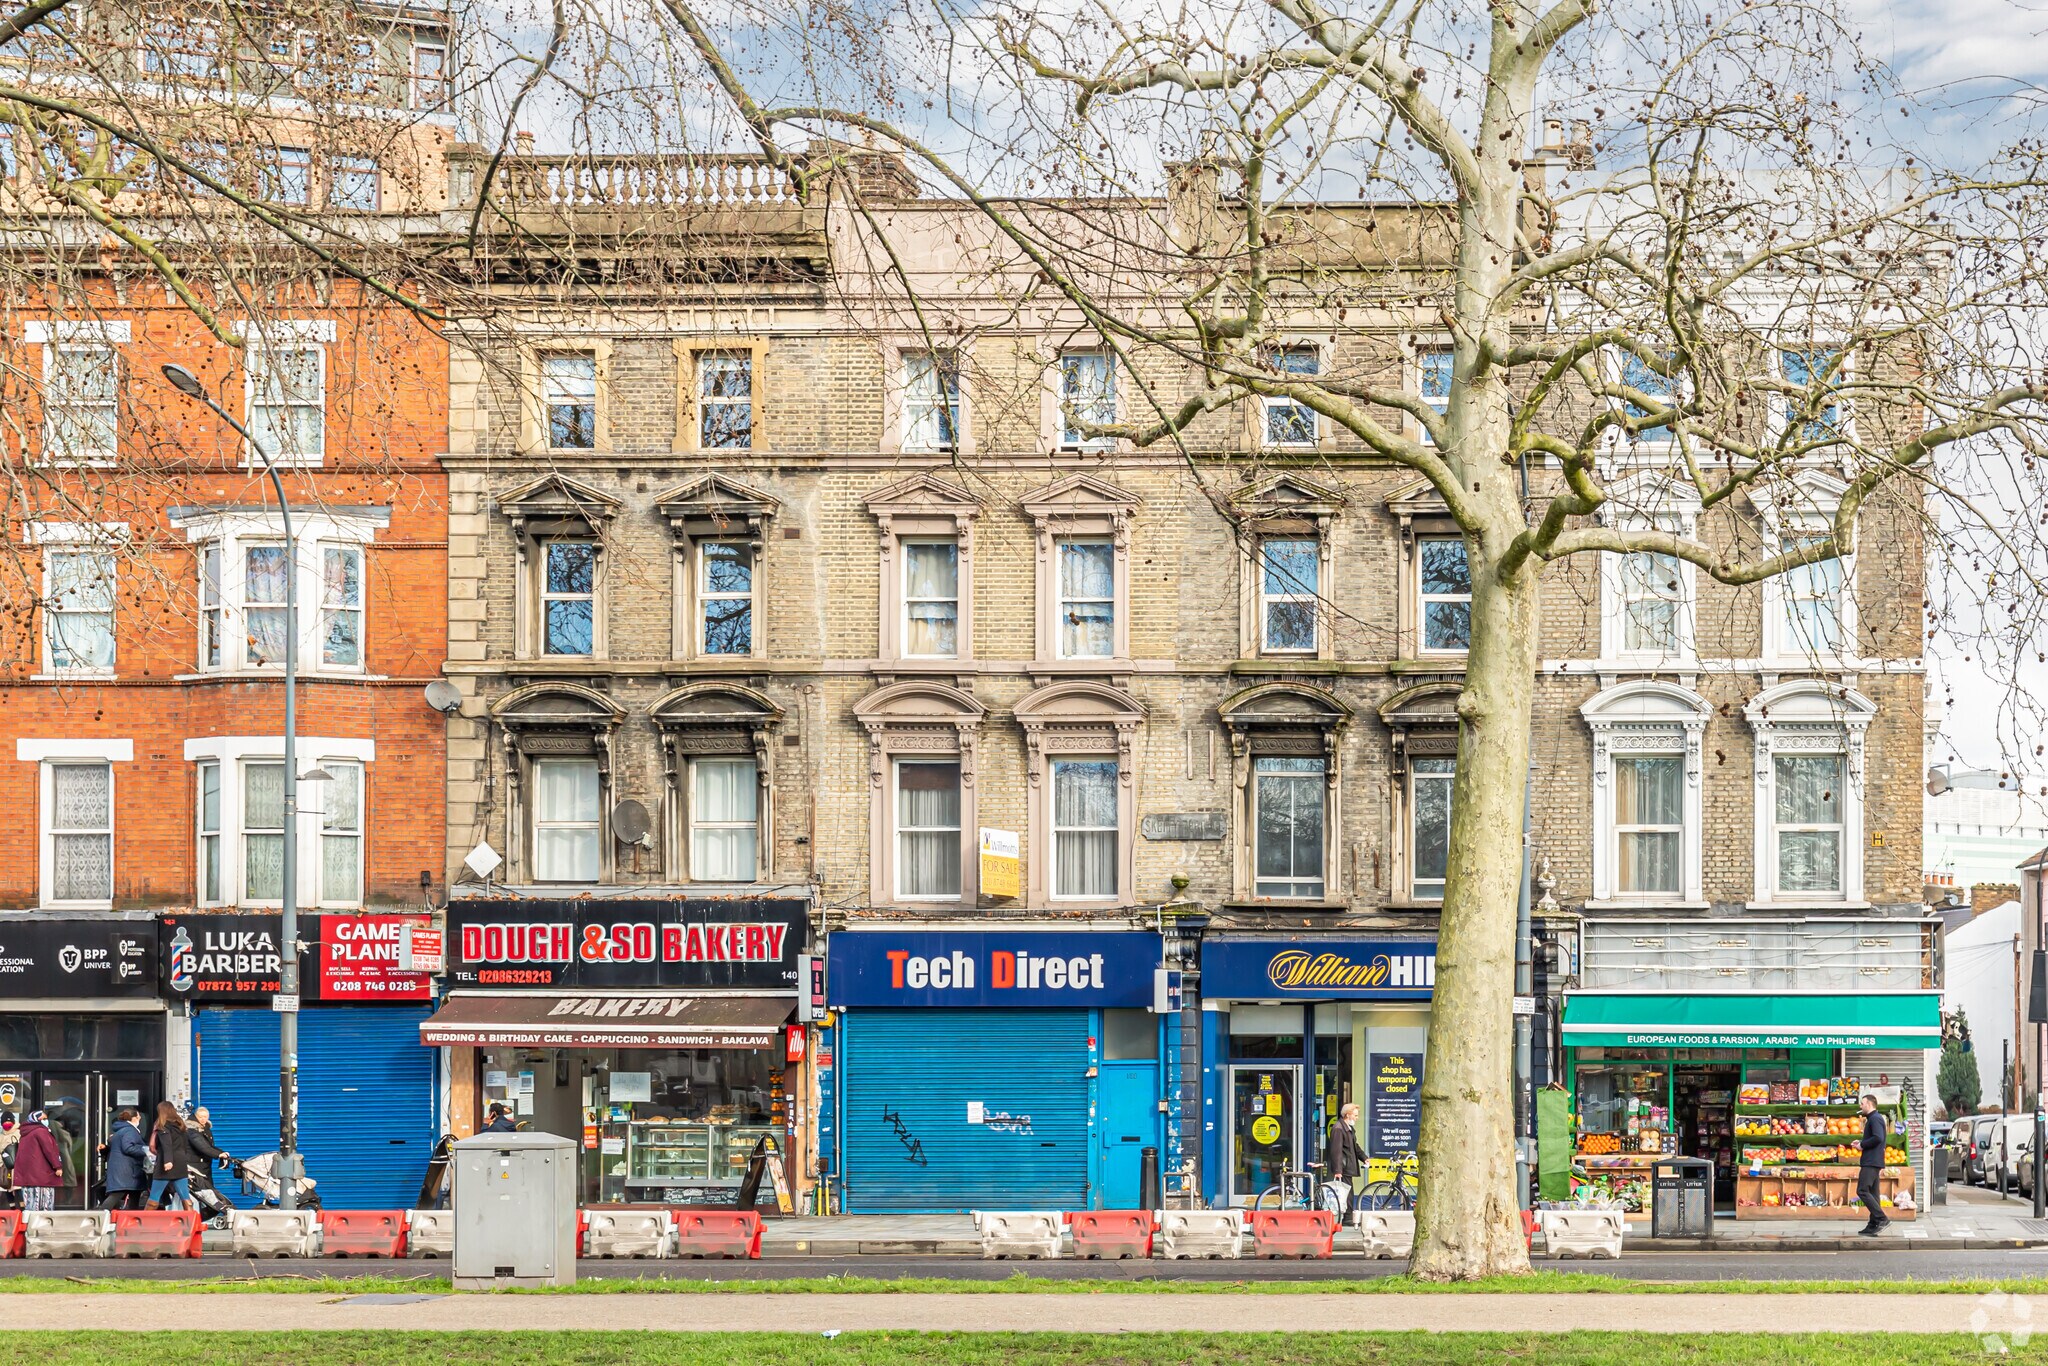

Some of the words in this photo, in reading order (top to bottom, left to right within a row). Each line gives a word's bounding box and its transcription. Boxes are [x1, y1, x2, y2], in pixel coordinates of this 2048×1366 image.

[1873, 833, 1883, 845] H
[983, 860, 999, 873] FOR
[1001, 862, 1017, 875] SALE
[336, 923, 400, 940] GAME
[205, 932, 274, 951] LUKA
[462, 923, 573, 963] DOUGH
[662, 923, 789, 963] BAKERY
[84, 949, 107, 959] BPP
[332, 943, 399, 960] PLANE
[456, 972, 477, 980] TEL:
[479, 970, 552, 983] 02086329213
[782, 971, 797, 979] 140
[886, 951, 975, 989] Tech
[992, 951, 1104, 989] Direct
[1267, 950, 1391, 991] William
[198, 982, 232, 991] 07872
[236, 982, 257, 991] 957
[333, 981, 361, 991] 0208
[365, 981, 385, 991] 746
[389, 981, 416, 991] 0285
[547, 999, 693, 1017] BAKERY
[426, 1033, 476, 1042] WEDDING
[478, 1034, 486, 1042] &
[489, 1034, 541, 1043] BIRTHDAY
[544, 1035, 572, 1043] CAKE
[581, 1035, 649, 1044] CAPPUCCINO
[722, 1036, 769, 1044] BAKLAVA
[790, 1030, 804, 1058] illy
[1826, 1037, 1876, 1045] PHILIPINES
[1382, 1066, 1399, 1075] shop
[1377, 1075, 1417, 1084] temporarily
